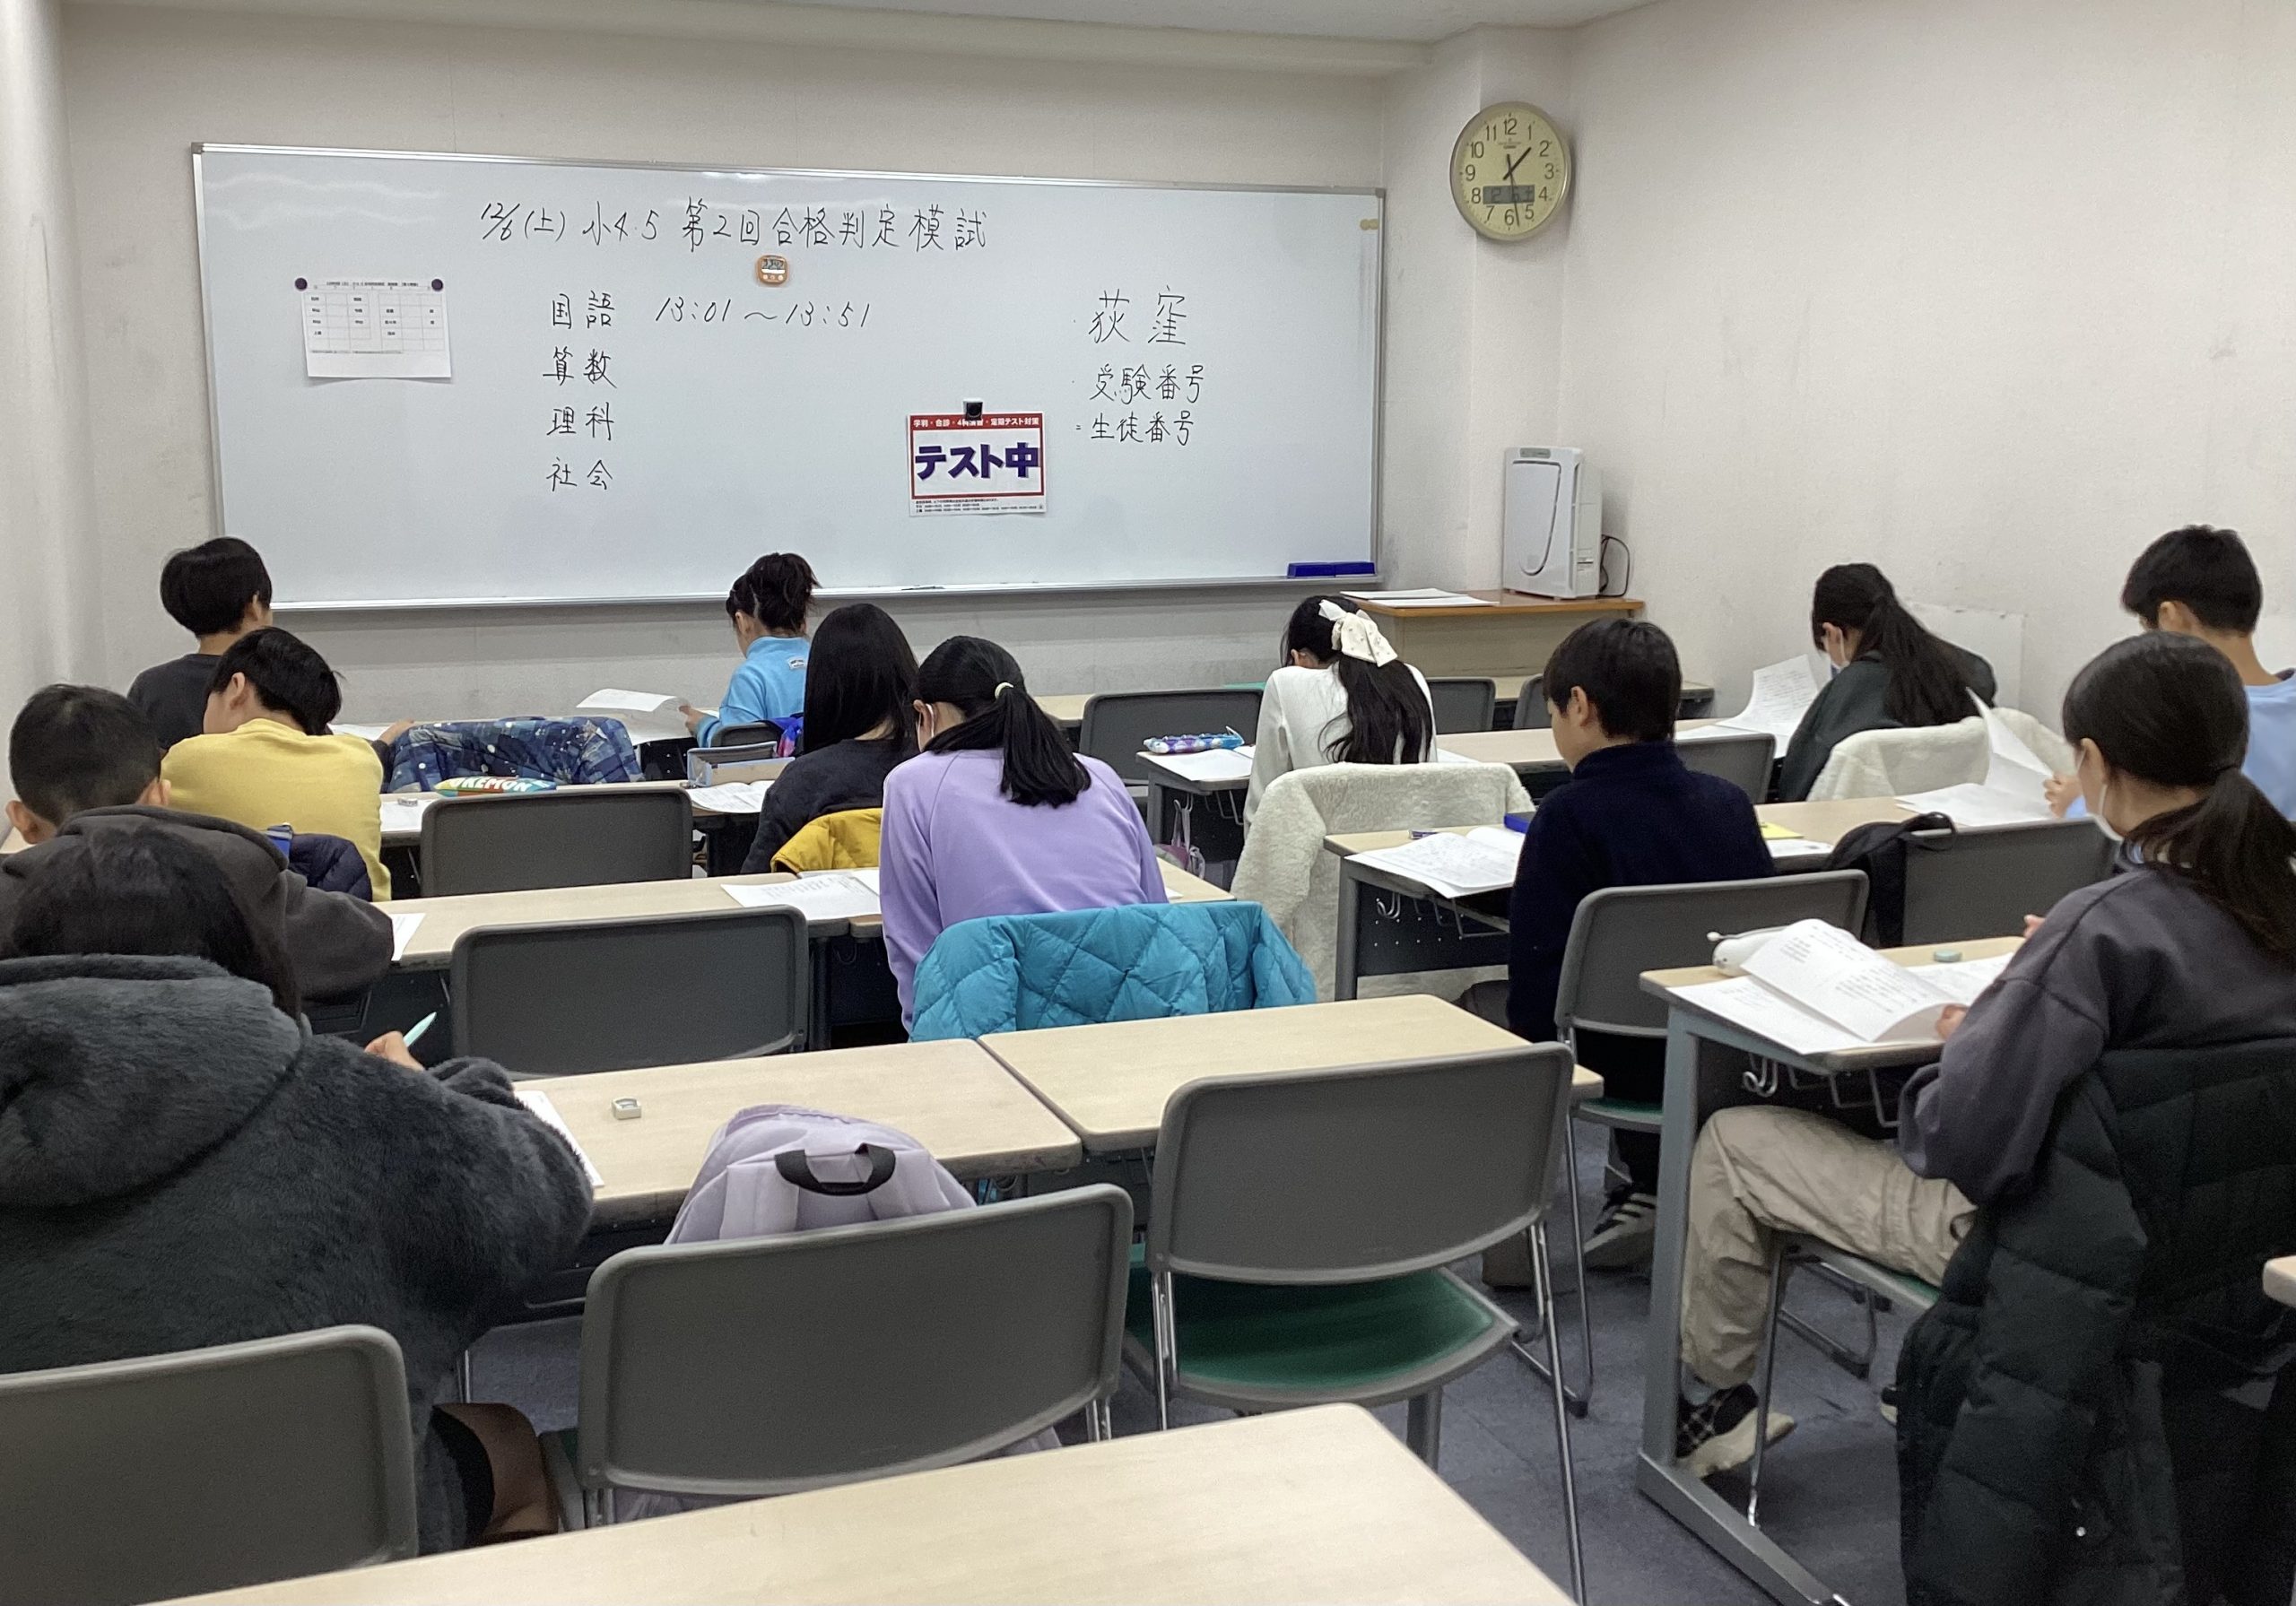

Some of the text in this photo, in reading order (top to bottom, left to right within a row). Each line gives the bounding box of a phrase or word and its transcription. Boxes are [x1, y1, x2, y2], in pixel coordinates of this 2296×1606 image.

[1485, 124, 1497, 141] 11
[1503, 117, 1518, 135] 12
[1526, 125, 1532, 141] 1
[1471, 141, 1484, 159] 10
[1539, 140, 1550, 157] 2
[1465, 164, 1475, 181] 9
[1544, 163, 1554, 179] 3
[1471, 187, 1481, 204] 8
[1538, 187, 1548, 202] 4
[1486, 205, 1495, 221] 7
[1504, 209, 1515, 226] 6
[1525, 204, 1535, 220] 5
[682, 195, 987, 253] 第2回合格判定模試
[552, 290, 615, 330] 国語
[1088, 284, 1187, 345] 荻窪
[542, 345, 618, 389] 算数
[1089, 362, 1205, 405] 受験番号
[545, 401, 615, 442] 理科
[1090, 410, 1195, 447] 生徒番号
[915, 442, 1040, 481] テスト中
[545, 456, 613, 492] 社会
